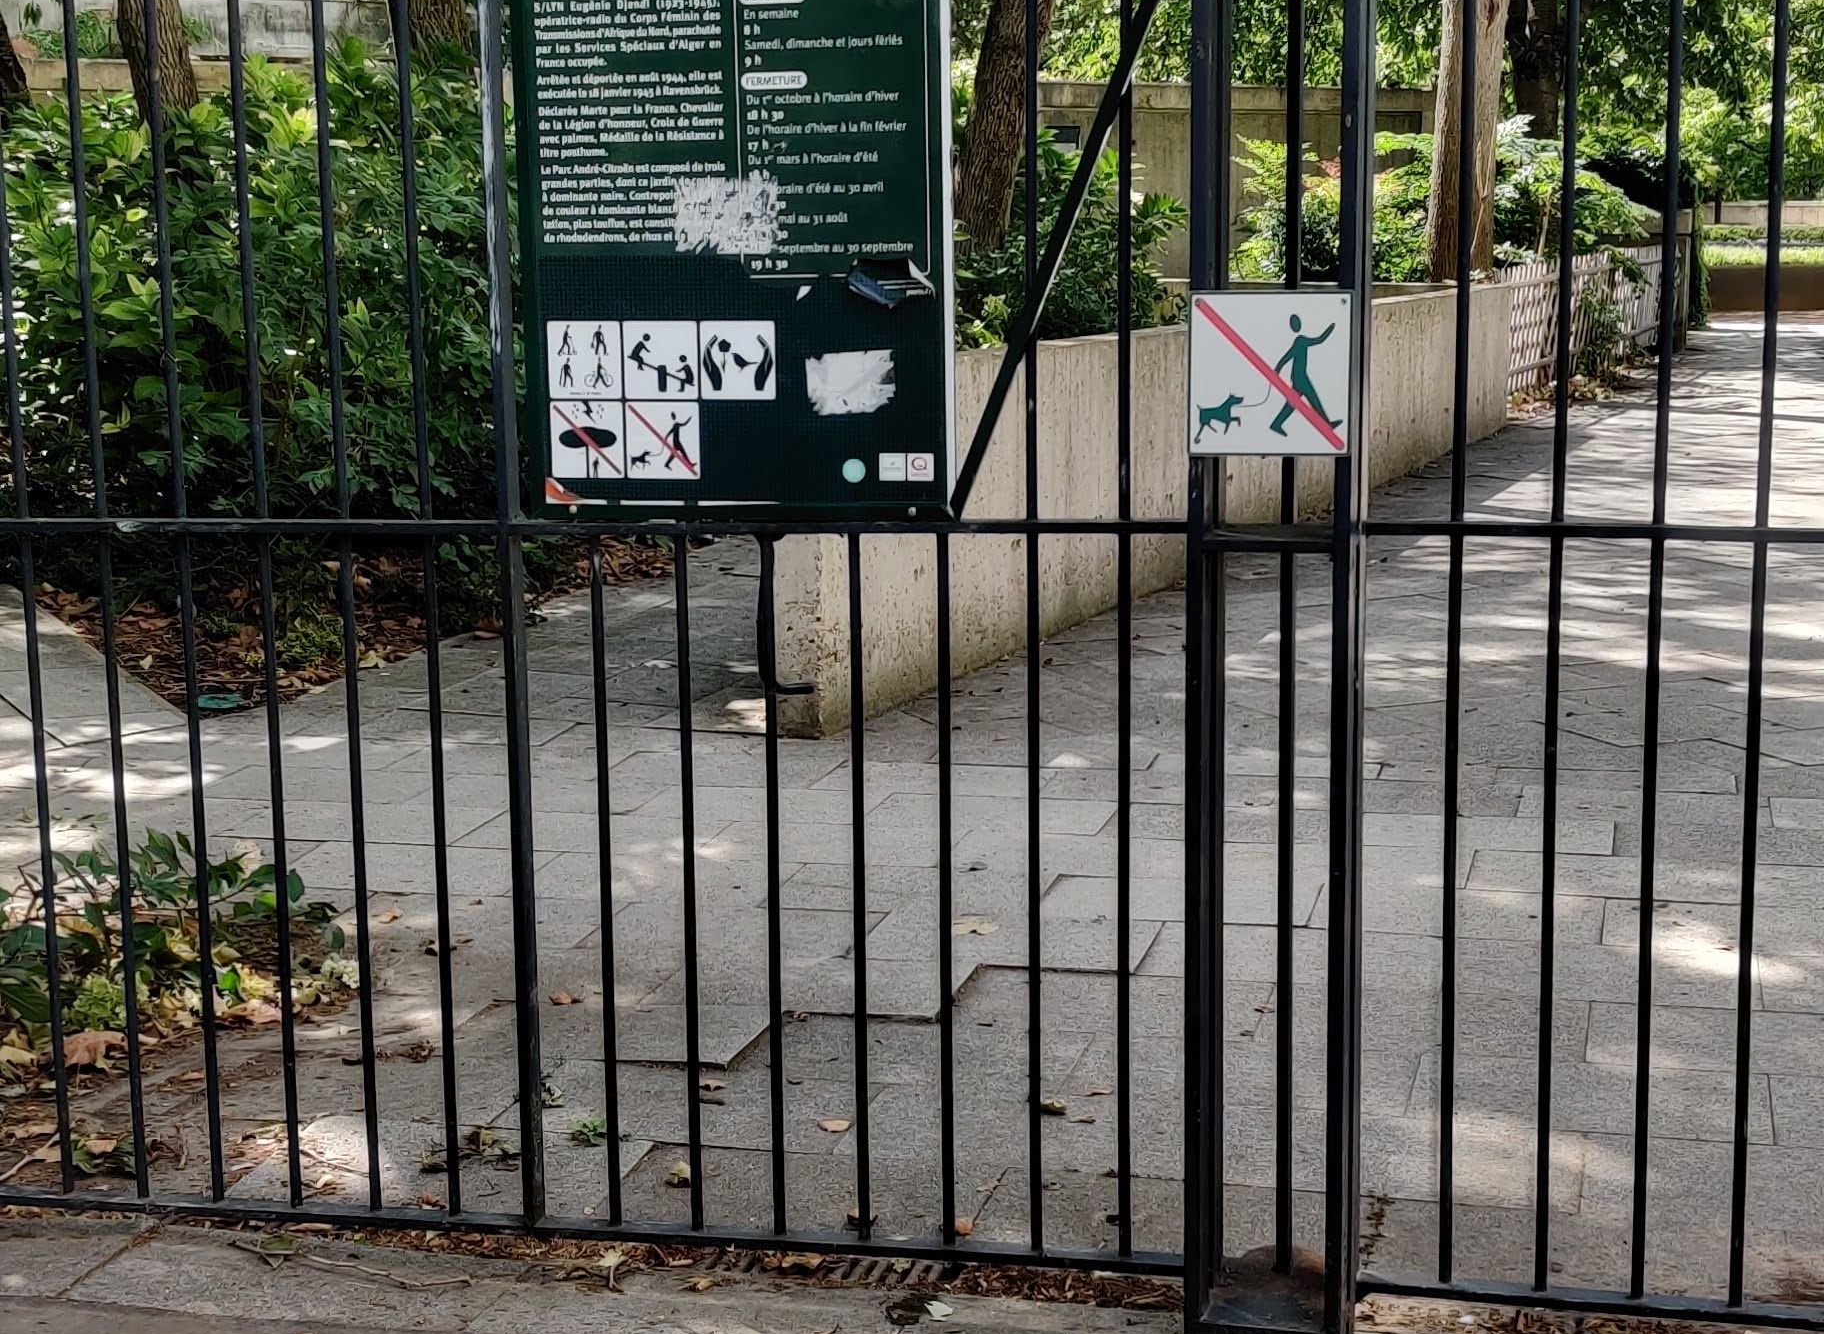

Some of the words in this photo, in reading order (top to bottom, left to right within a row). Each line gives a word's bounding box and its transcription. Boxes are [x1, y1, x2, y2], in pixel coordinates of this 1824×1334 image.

[744, 9, 755, 20] En
[758, 8, 799, 19] semaine
[744, 25, 750, 35] 8
[754, 24, 760, 35] h
[745, 39, 784, 51] Samedi,
[786, 37, 833, 49] dimanche
[836, 37, 846, 47] et
[848, 37, 873, 49] jours
[875, 34, 903, 46] fériés
[745, 57, 751, 67] 9
[755, 55, 762, 65] h
[746, 75, 802, 86] FERMETURE
[747, 94, 759, 105] Du
[775, 93, 812, 104] octobre
[814, 93, 820, 102] à
[761, 109, 768, 120] h
[771, 111, 784, 122] 30
[747, 125, 759, 135] De
[840, 122, 846, 132] à
[849, 122, 857, 132] la
[860, 121, 872, 132] fin
[875, 120, 906, 131] février
[762, 139, 768, 150] h
[748, 155, 761, 165] Du
[776, 156, 800, 164] mars
[803, 153, 808, 164] à
[853, 151, 878, 163] d'été
[806, 181, 830, 193] d'été
[833, 184, 845, 192] au
[848, 185, 860, 195] 30
[863, 180, 884, 192] avril
[778, 212, 795, 224] mai
[798, 216, 810, 224] au
[812, 216, 823, 226] 31
[826, 212, 848, 223] août
[779, 242, 830, 255] septembre
[832, 245, 844, 253] au
[847, 244, 859, 254] 30
[862, 241, 913, 254] septembre
[765, 258, 772, 268] h
[776, 259, 788, 271] 30
